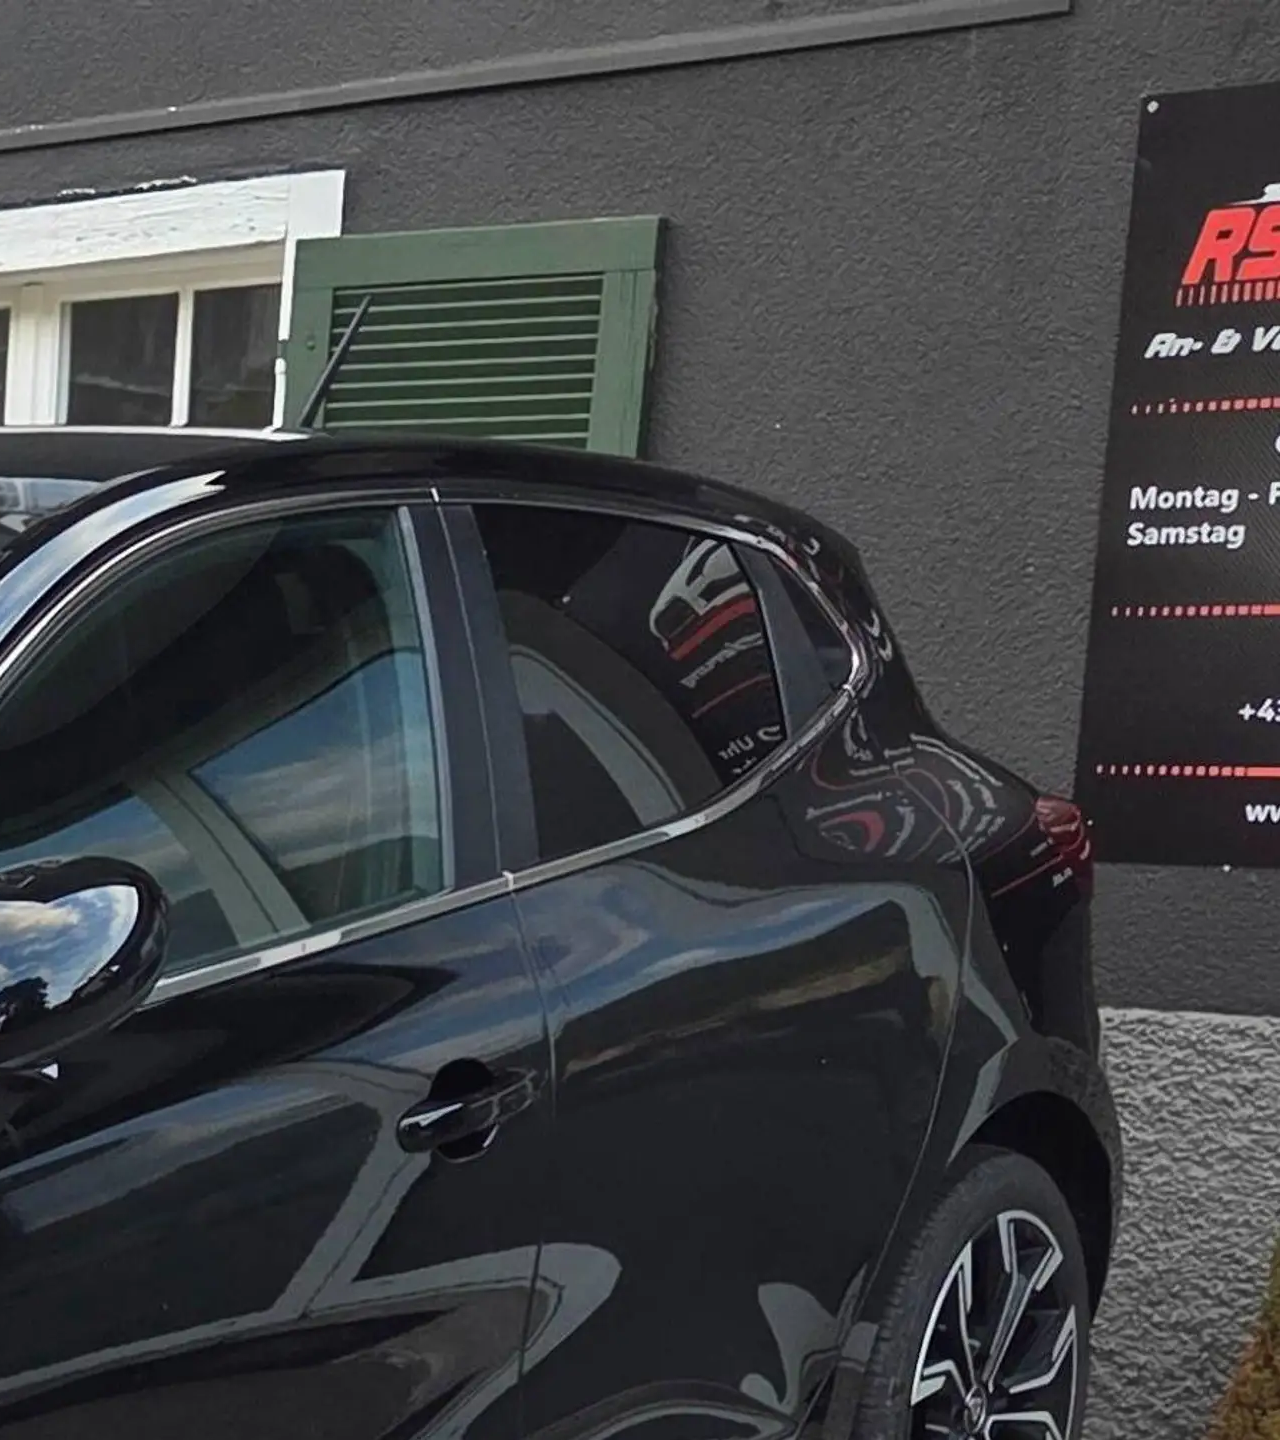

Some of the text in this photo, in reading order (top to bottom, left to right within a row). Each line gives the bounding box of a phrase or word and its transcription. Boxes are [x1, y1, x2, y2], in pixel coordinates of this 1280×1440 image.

[1181, 204, 1280, 285] RS
[1211, 328, 1242, 354] &
[1129, 486, 1239, 512] Montag
[1127, 522, 1246, 549] Samstag
